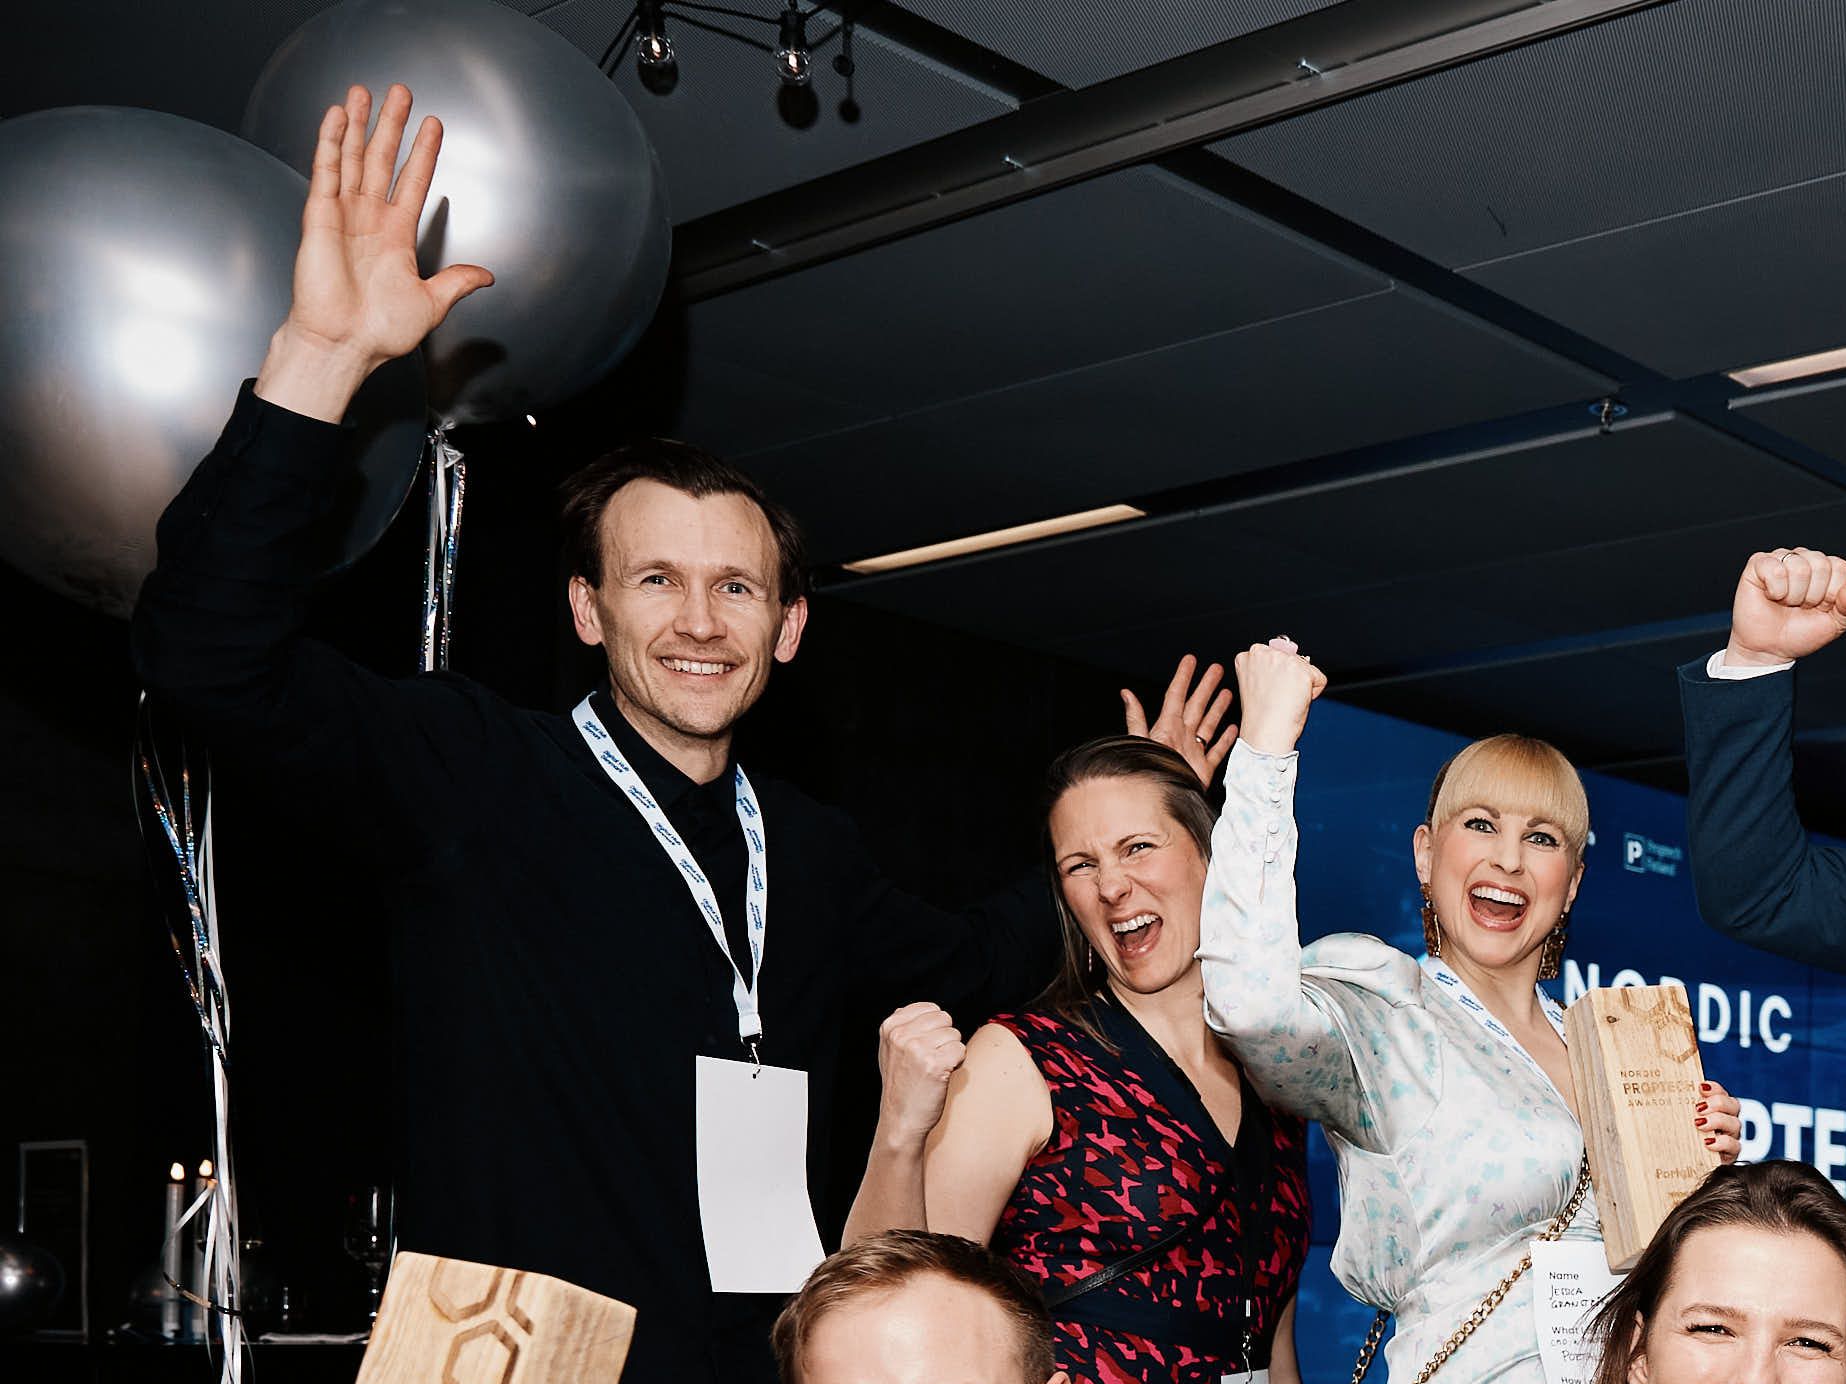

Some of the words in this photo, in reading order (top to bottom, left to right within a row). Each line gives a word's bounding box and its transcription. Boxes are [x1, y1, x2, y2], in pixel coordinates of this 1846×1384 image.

[1620, 1069, 1661, 1078] NORDIC
[1623, 1081, 1696, 1095] PROPTECH
[1549, 1271, 1580, 1281] Name
[1552, 1326, 1579, 1335] What
[1561, 1376, 1582, 1384] How
